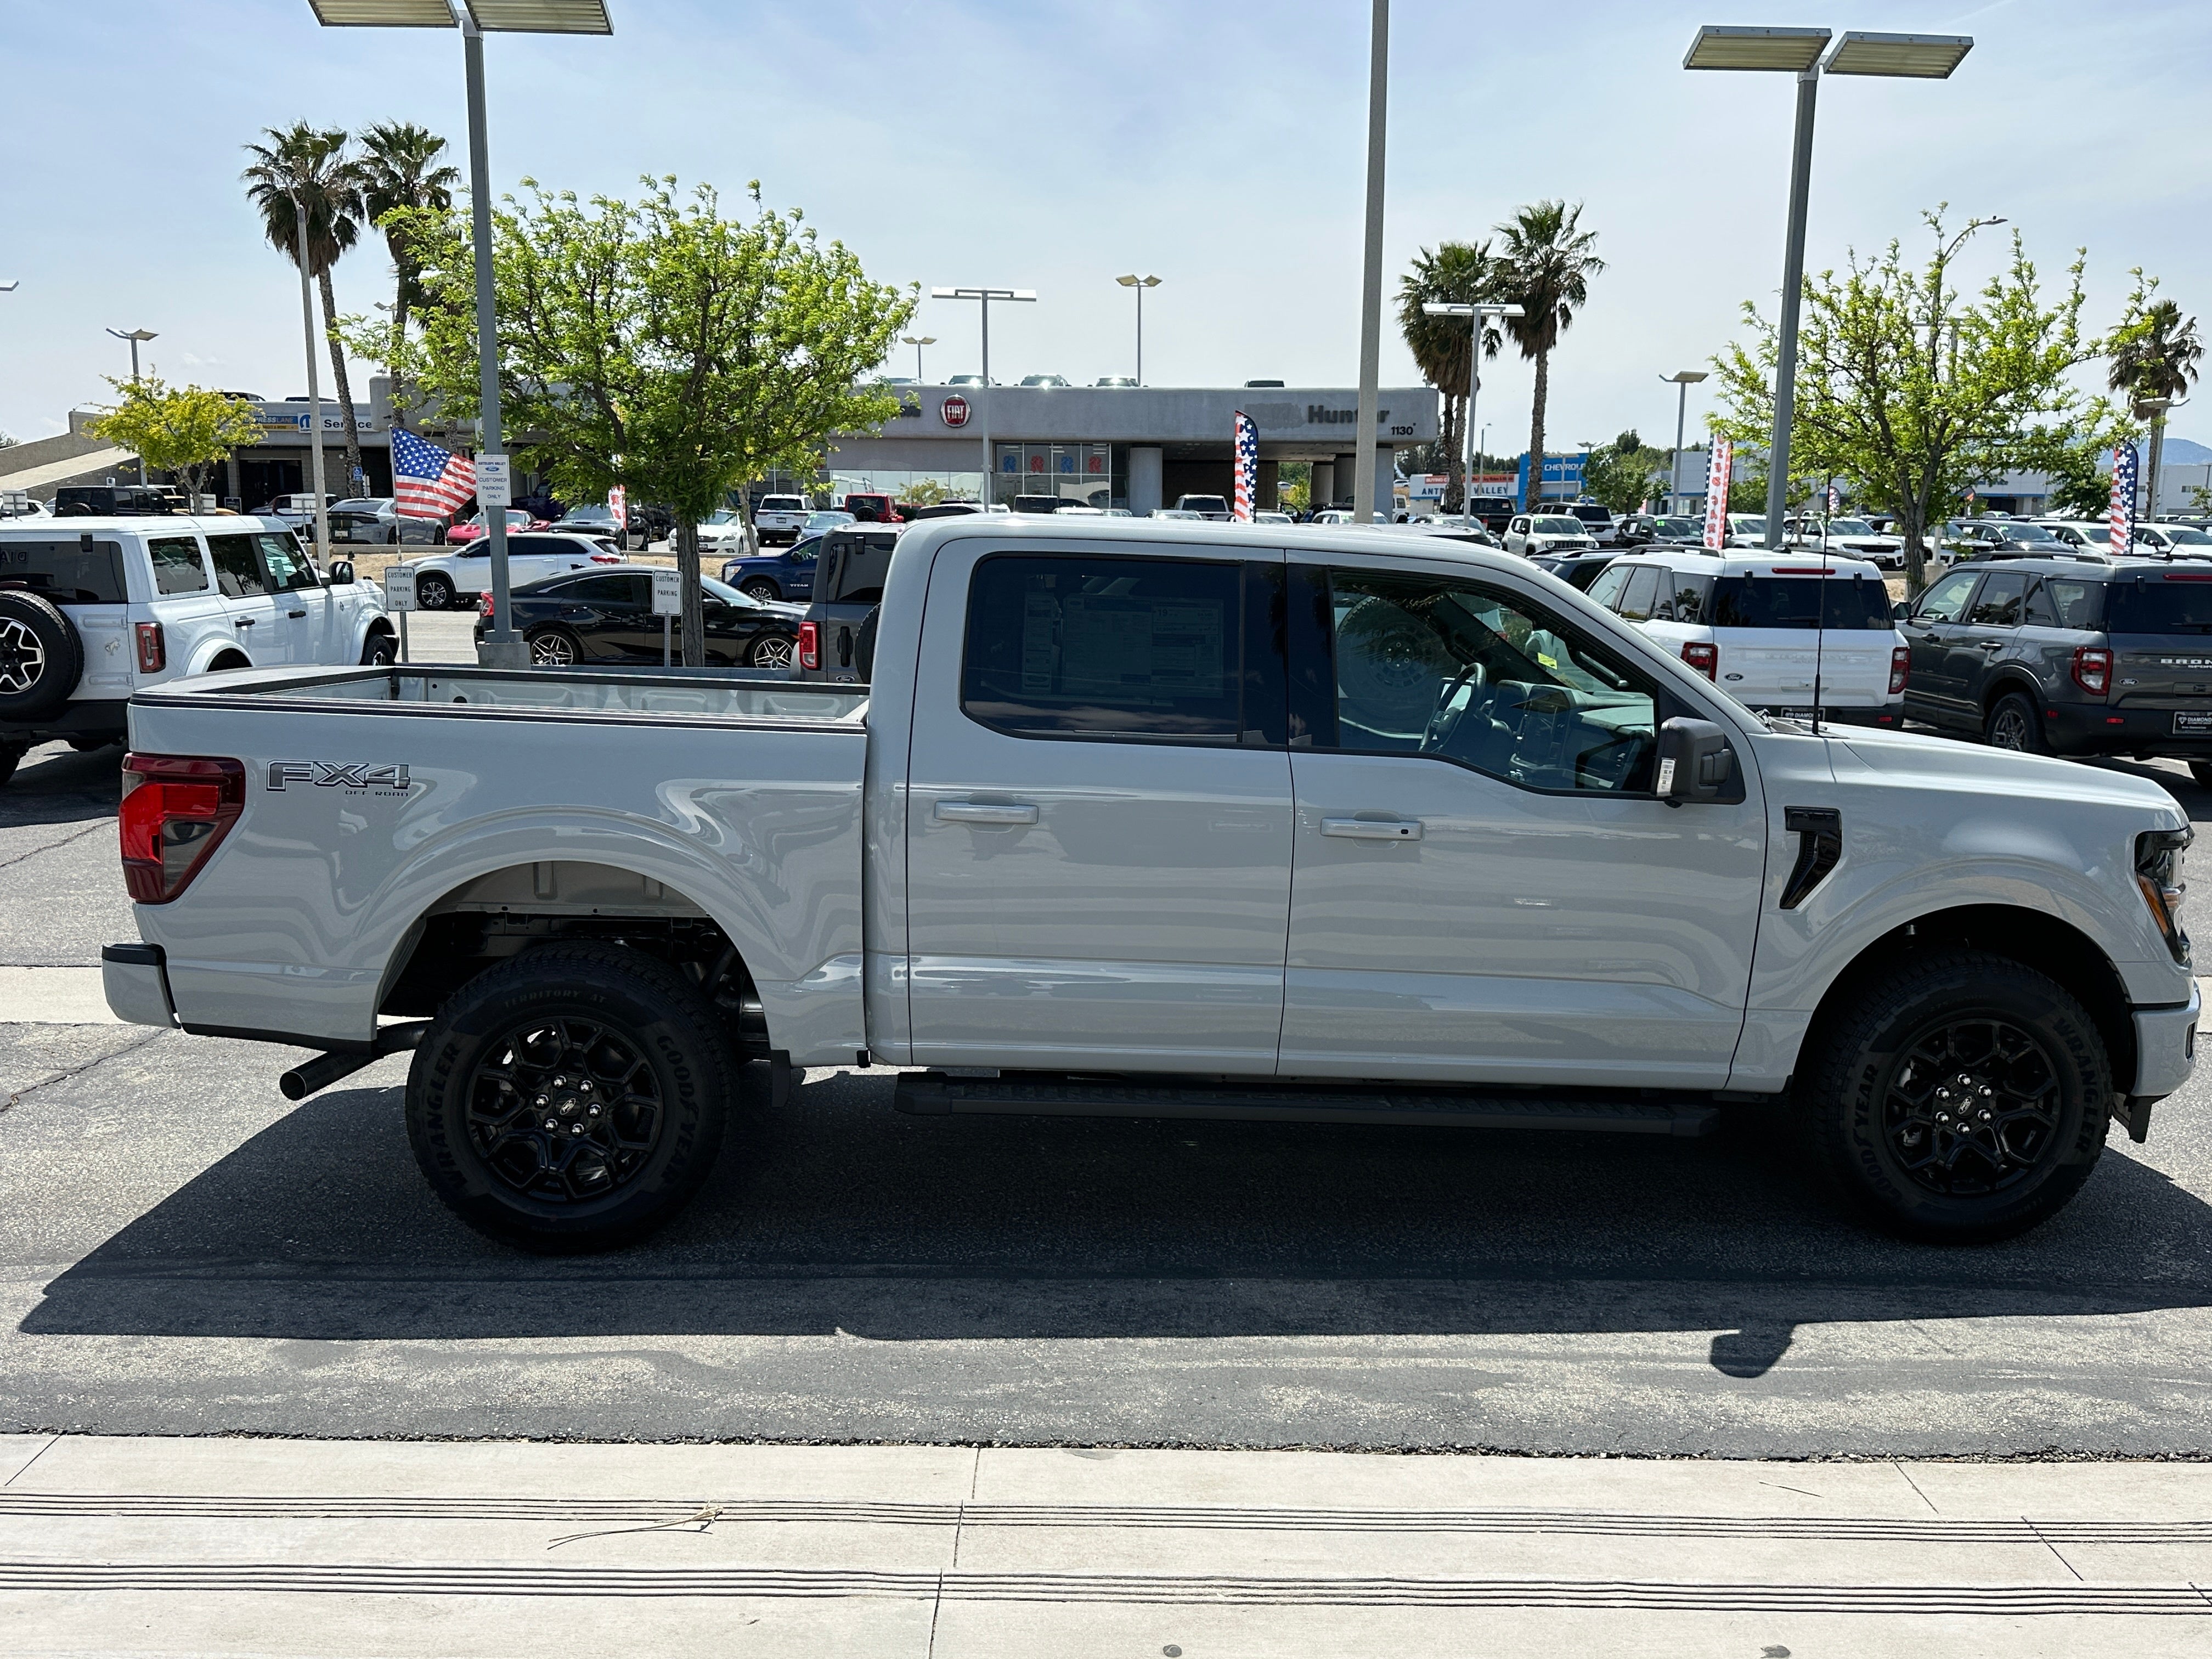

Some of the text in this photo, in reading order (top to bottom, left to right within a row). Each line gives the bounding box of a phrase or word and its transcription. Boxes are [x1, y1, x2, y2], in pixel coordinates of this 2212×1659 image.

[947, 405, 964, 419] FIAT
[1308, 405, 1390, 424] Hunr
[1391, 426, 1413, 436] 1130
[266, 759, 411, 792] FX4
[504, 989, 583, 1008] TERRITORY
[2053, 1018, 2100, 1154] WRANGLER
[427, 1042, 469, 1190] WRANGLER
